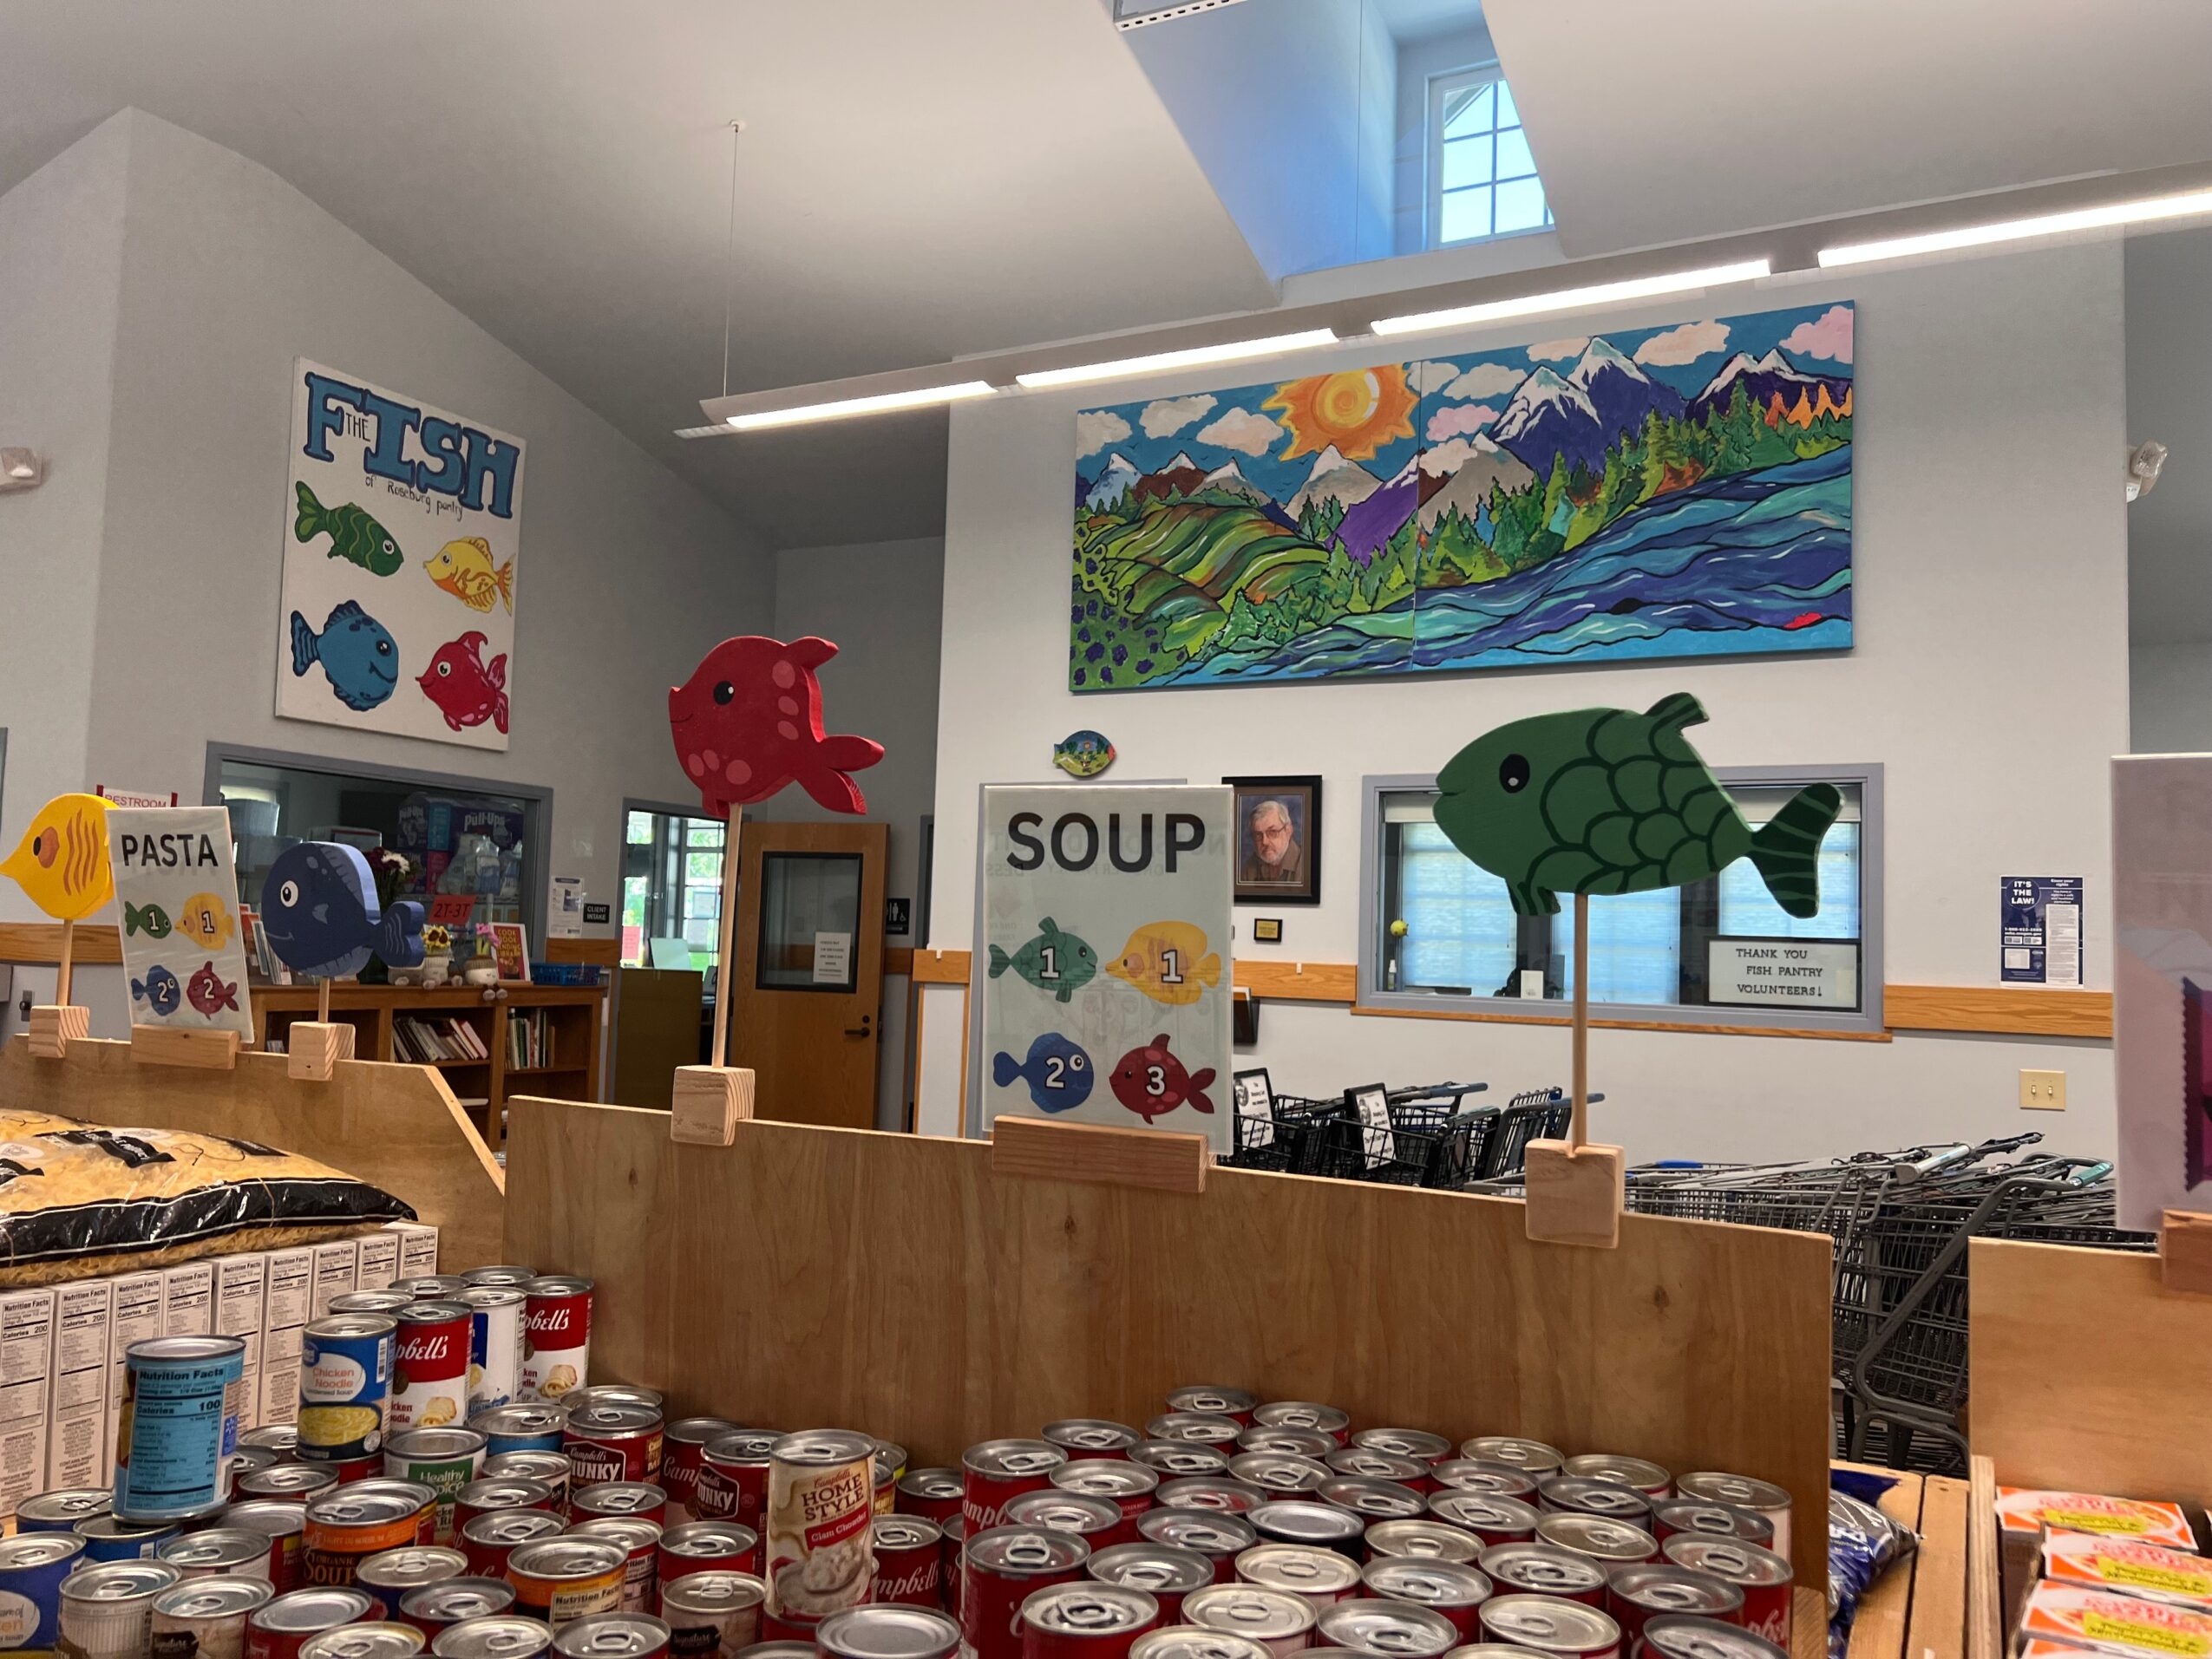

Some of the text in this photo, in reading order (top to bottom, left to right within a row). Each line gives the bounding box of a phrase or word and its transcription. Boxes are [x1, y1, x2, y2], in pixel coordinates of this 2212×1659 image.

[346, 413, 370, 441] THE
[304, 372, 520, 519] FISH
[365, 476, 463, 522] of Roseburg pantry
[121, 833, 219, 867] PASTA
[1005, 812, 1206, 873] SOUP
[434, 903, 471, 918] 2T-3T
[148, 910, 160, 931] 1
[202, 911, 215, 933] 1
[1040, 945, 1061, 979] 1
[1736, 948, 1808, 959] THANK YOU
[1161, 949, 1184, 984] 1
[1746, 966, 1823, 977] FISH PANTRY
[157, 982, 169, 1003] 2
[203, 977, 215, 999] 2
[1737, 983, 1823, 996] VOLUNTEERS!
[1044, 1055, 1066, 1089] 2
[1145, 1064, 1166, 1096] 3
[224, 1264, 246, 1272] Nutrition
[274, 1257, 295, 1266] Nutrition
[119, 1283, 143, 1292] Nutrition
[169, 1274, 193, 1283] Nutrition
[4, 1301, 31, 1311] Nutrition
[63, 1291, 88, 1302] Nutrition
[168, 1300, 192, 1309] Calories
[62, 1314, 106, 1328] Calories 200
[117, 1309, 141, 1317] Calories
[525, 1308, 570, 1330] pbell's
[3, 1325, 48, 1339] Calories 200
[396, 1336, 448, 1361] pbell's
[140, 1368, 225, 1381] Nutrition Facts
[312, 1367, 354, 1377] Chicken
[315, 1378, 354, 1388] Noodle
[136, 1399, 221, 1414] Calories 100
[390, 1401, 412, 1412] icken
[390, 1414, 410, 1423] oodle
[570, 1447, 607, 1462] Campbell's
[420, 1469, 465, 1485] Healthy
[572, 1461, 621, 1481] HUNKY
[813, 1469, 853, 1489] Campbell's
[697, 1483, 735, 1512] HUNKY
[802, 1473, 862, 1506] HOME
[805, 1486, 864, 1521] STYLE
[811, 1510, 867, 1542] Clam Chowder
[304, 1547, 357, 1584] SOUP
[877, 1560, 939, 1601] mpbell's
[555, 1584, 620, 1603] Nutrition Facts
